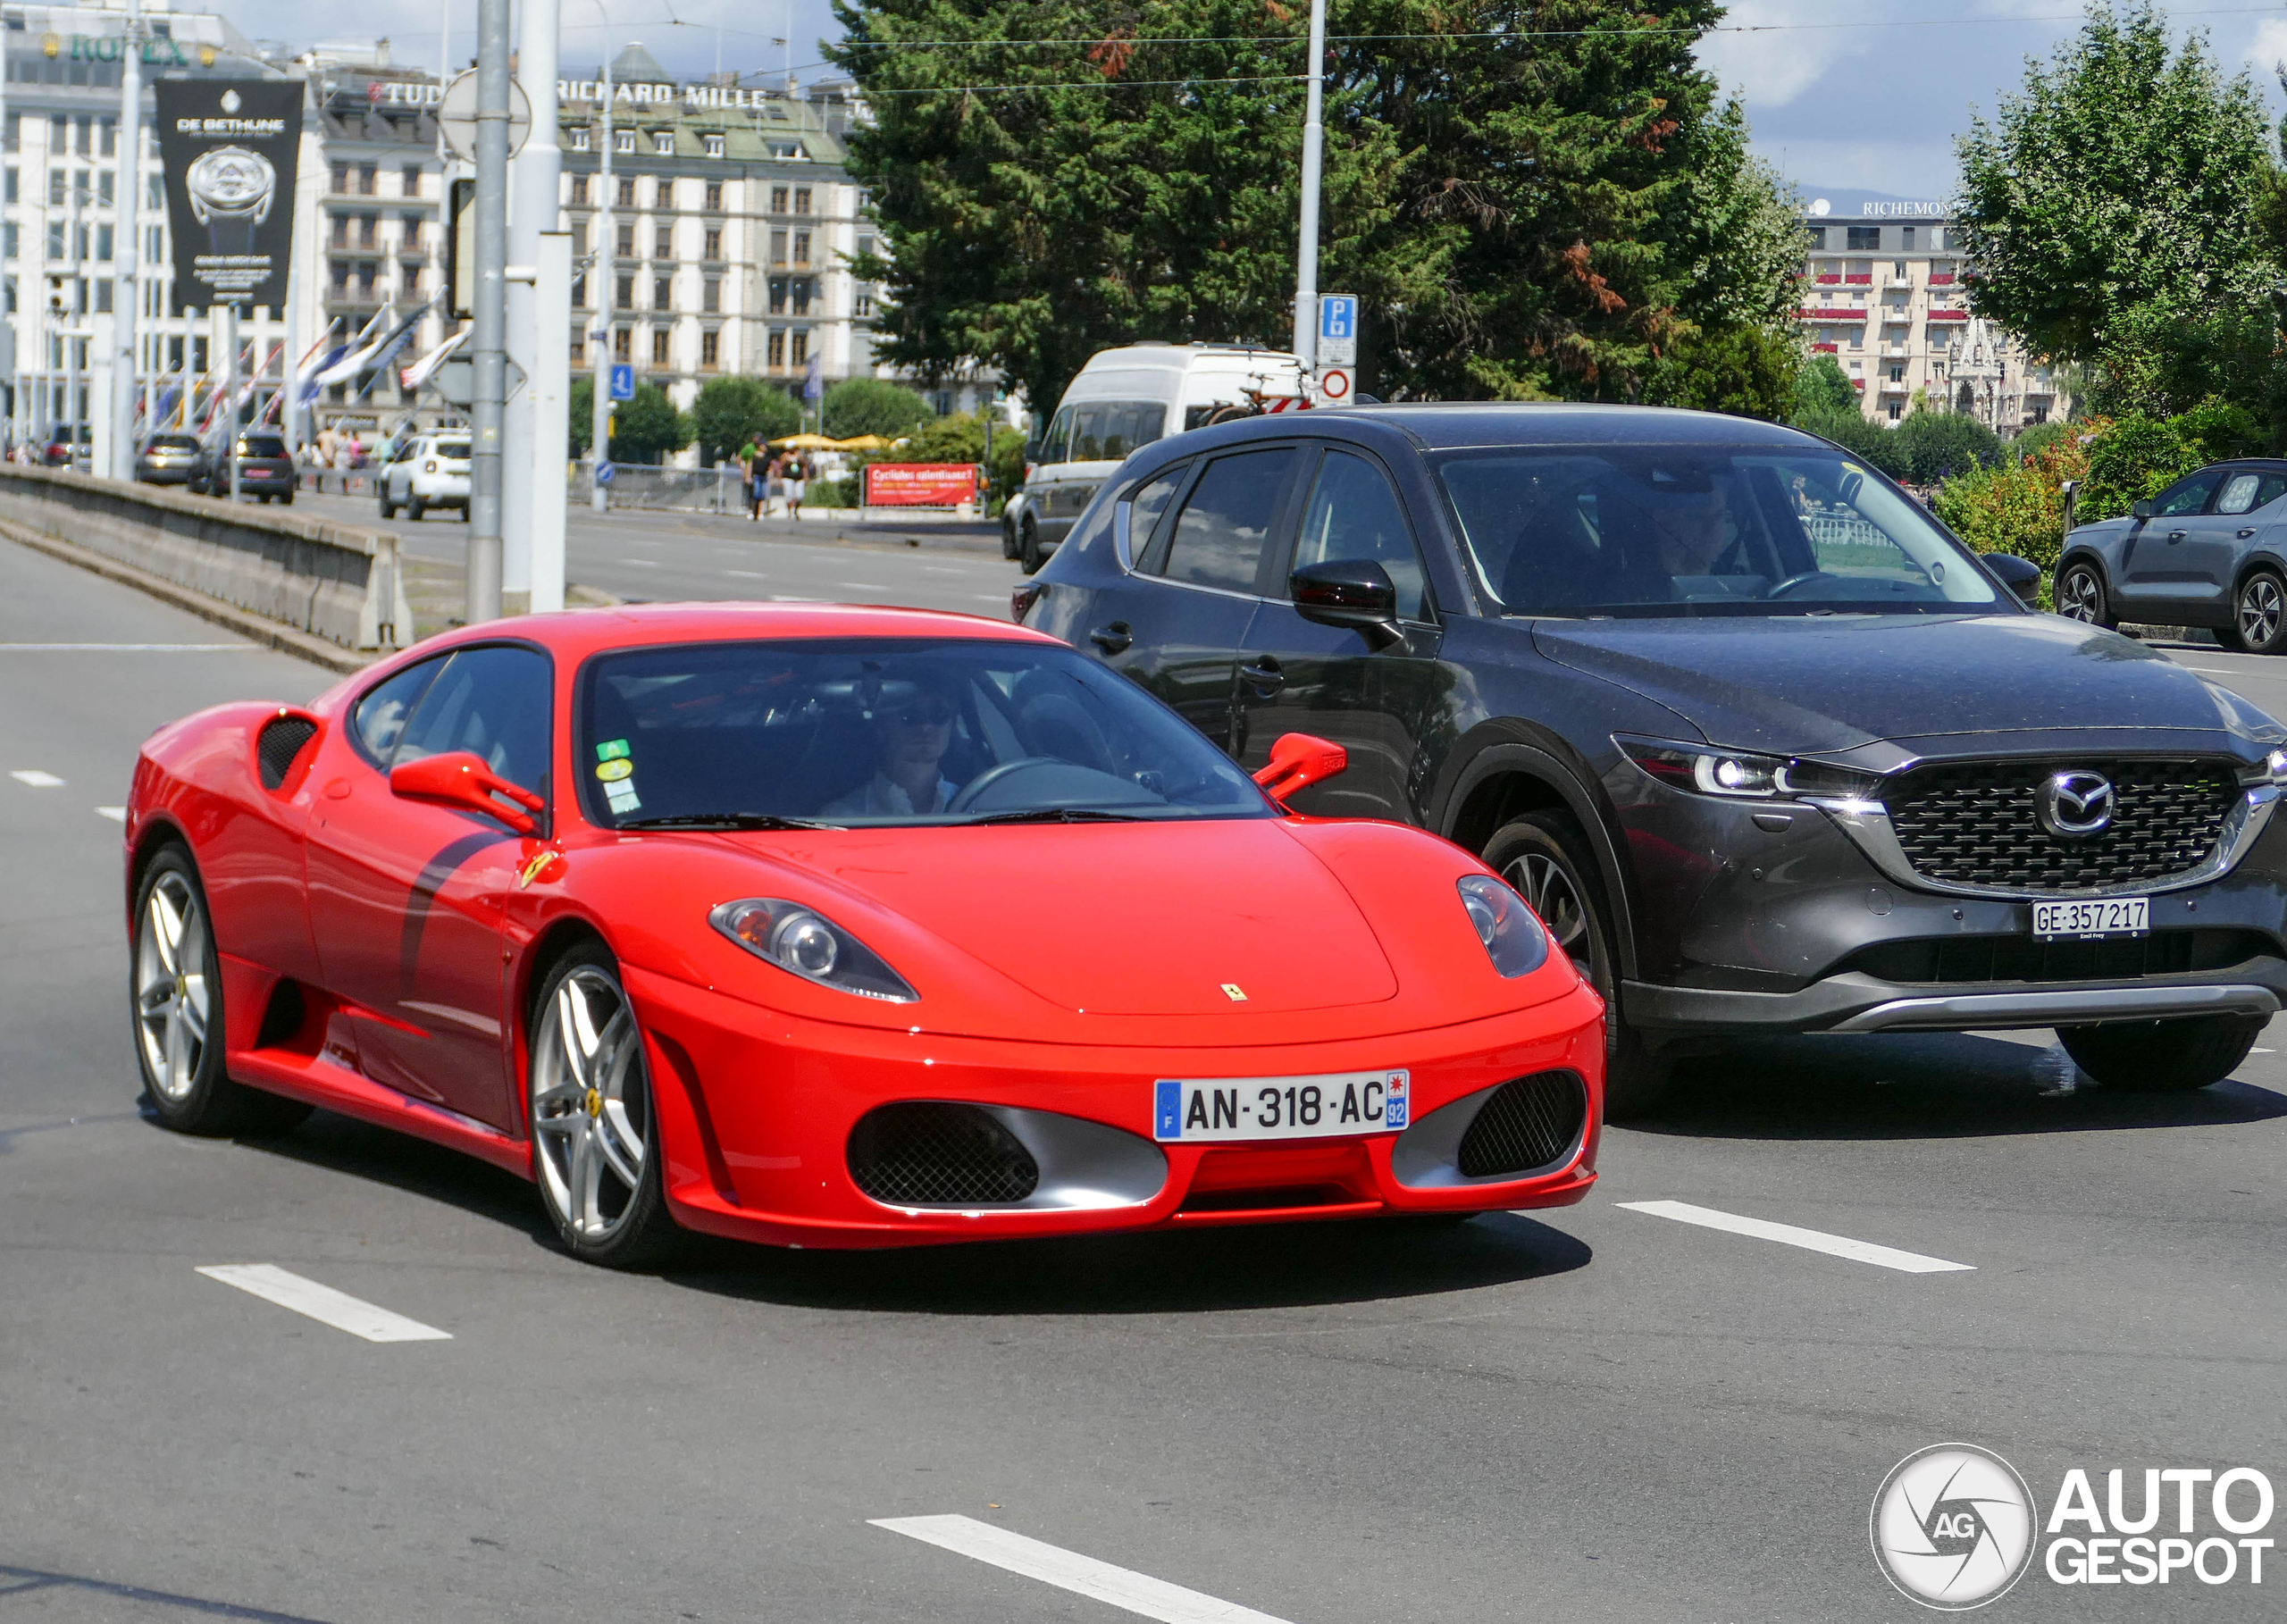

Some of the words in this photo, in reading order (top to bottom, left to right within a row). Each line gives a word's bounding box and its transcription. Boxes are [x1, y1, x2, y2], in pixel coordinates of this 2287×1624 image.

[685, 86, 767, 109] MILLE
[177, 118, 202, 132] DE
[203, 118, 285, 133] BETHUNE
[1332, 300, 1345, 321] P
[1164, 1117, 1173, 1129] F
[1387, 1102, 1404, 1124] 92
